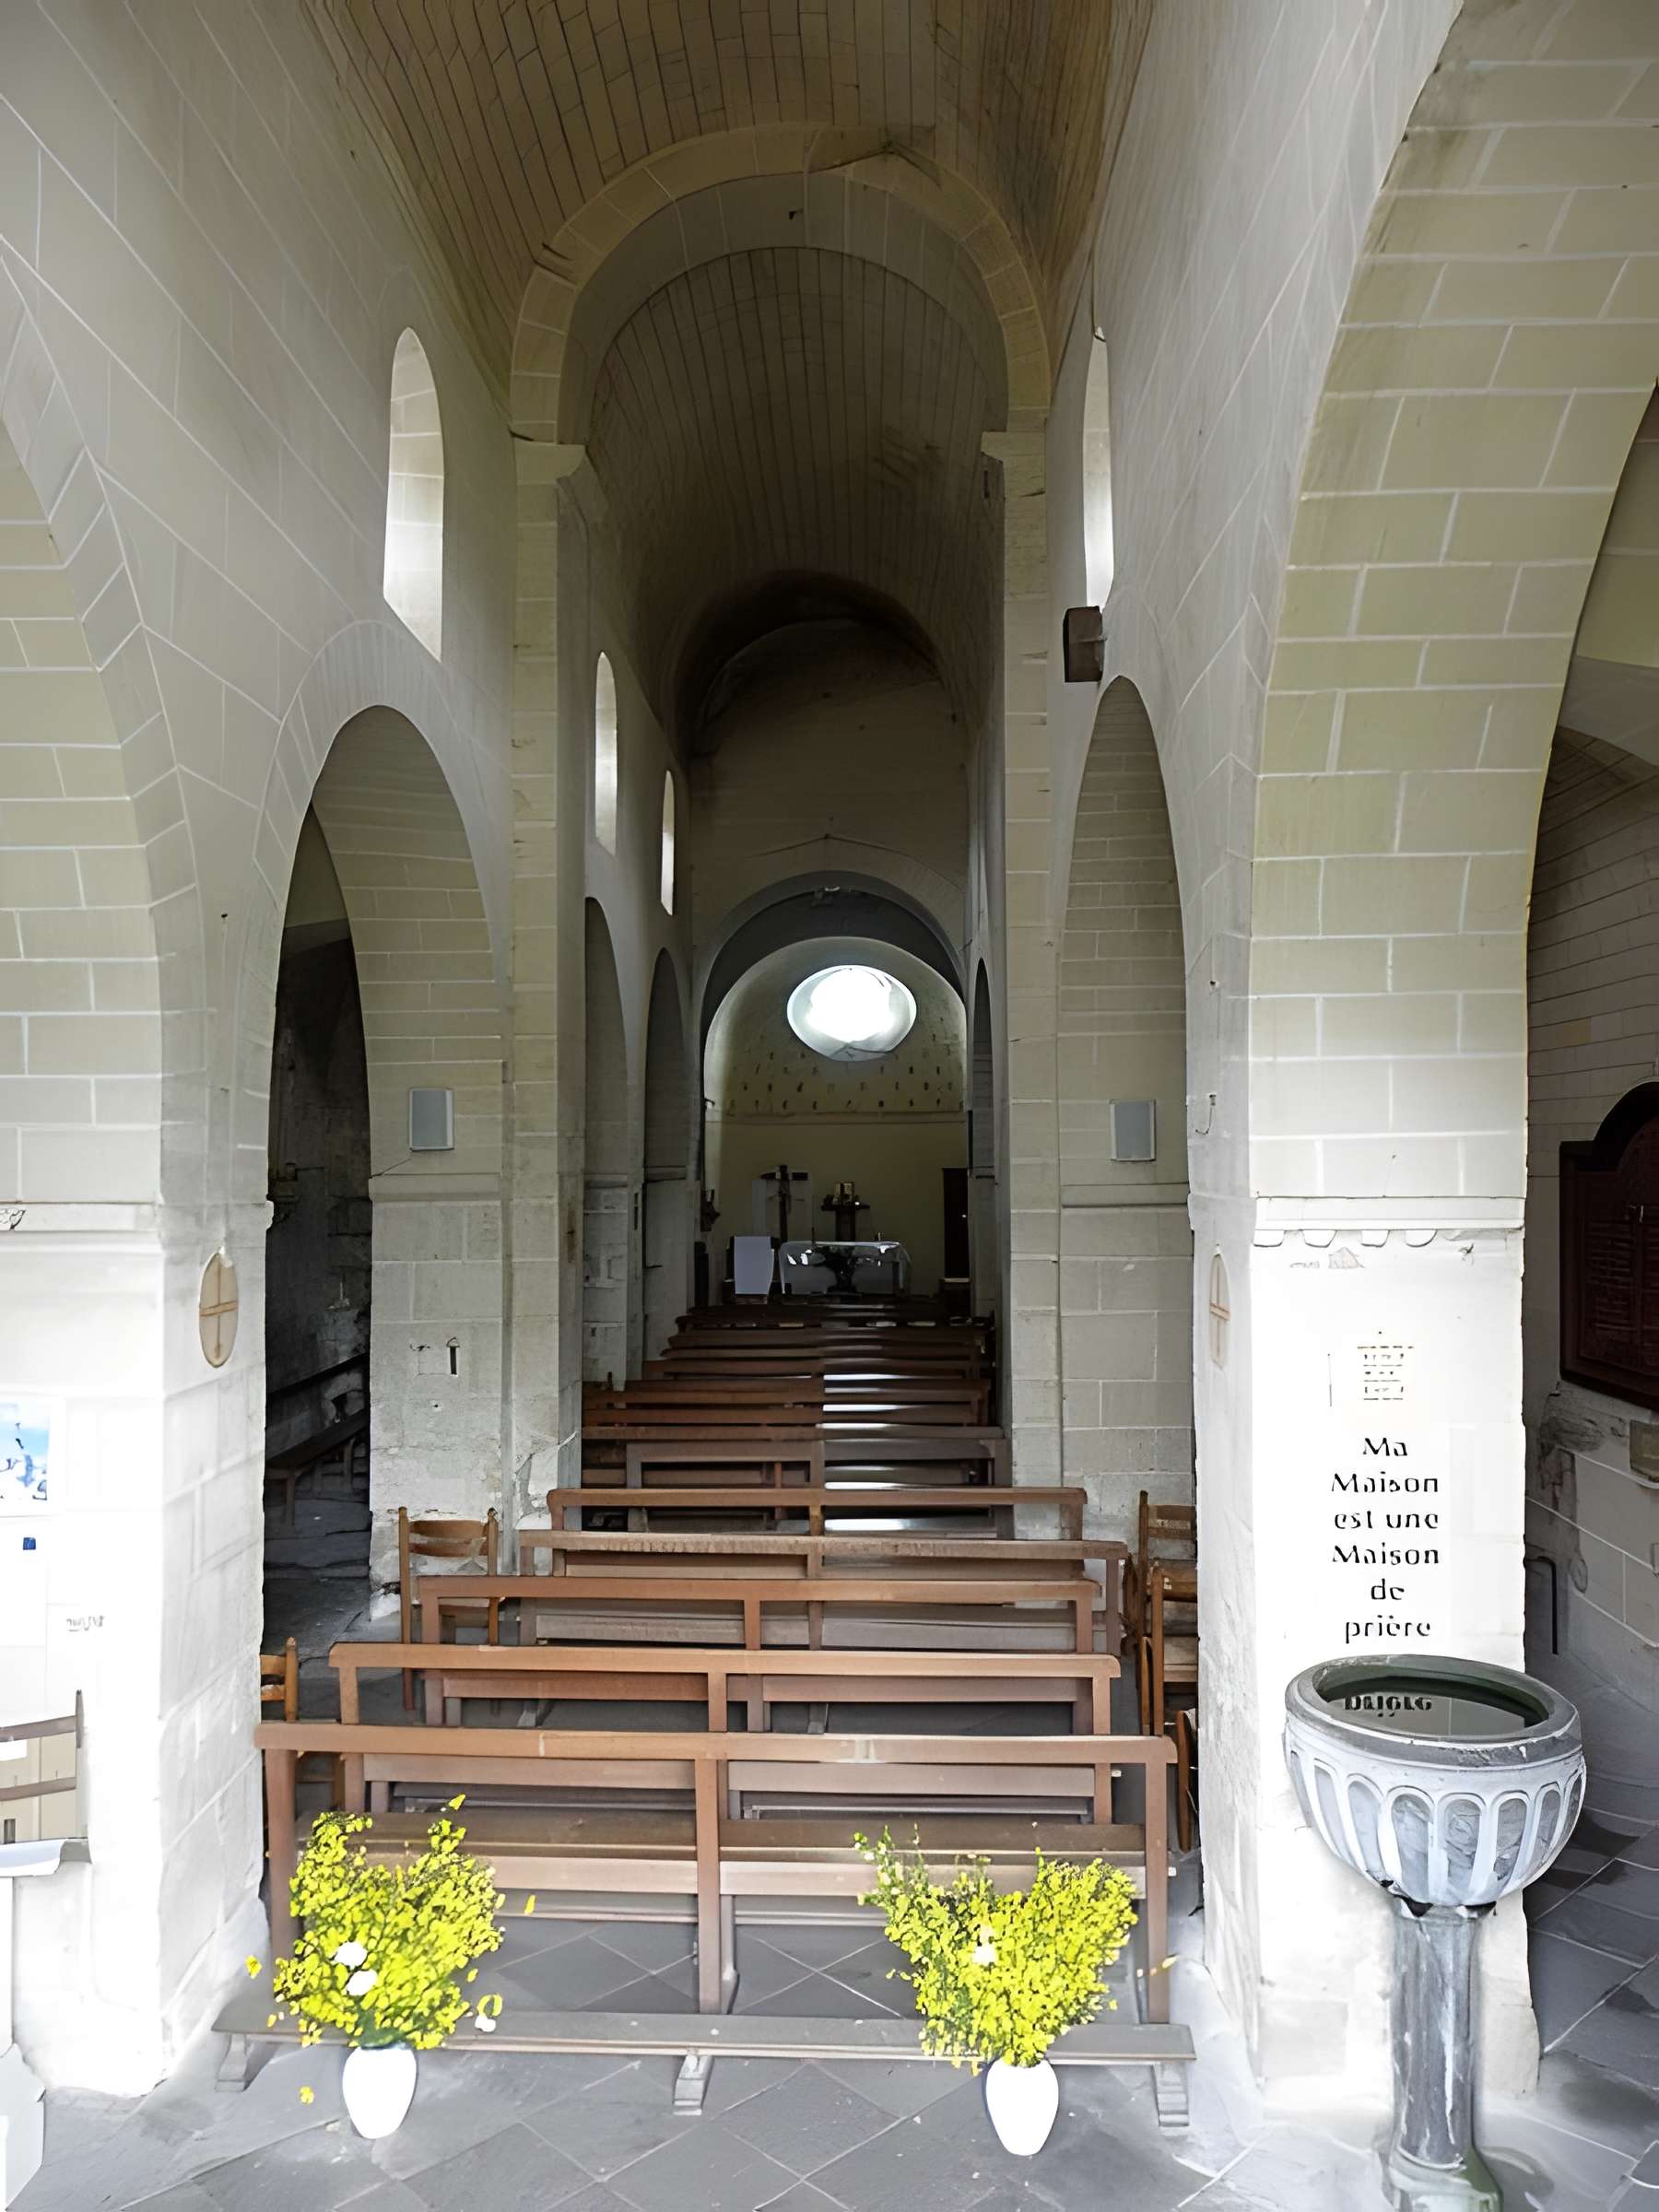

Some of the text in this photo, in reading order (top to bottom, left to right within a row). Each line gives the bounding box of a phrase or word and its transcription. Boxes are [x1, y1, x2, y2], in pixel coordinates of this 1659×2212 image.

[1362, 1437, 1408, 1457] Ma
[1331, 1470, 1439, 1493] Maison
[1334, 1510, 1439, 1530] est une
[1332, 1541, 1440, 1566] Maison
[1370, 1577, 1406, 1601] de
[1345, 1614, 1431, 1645] prière
